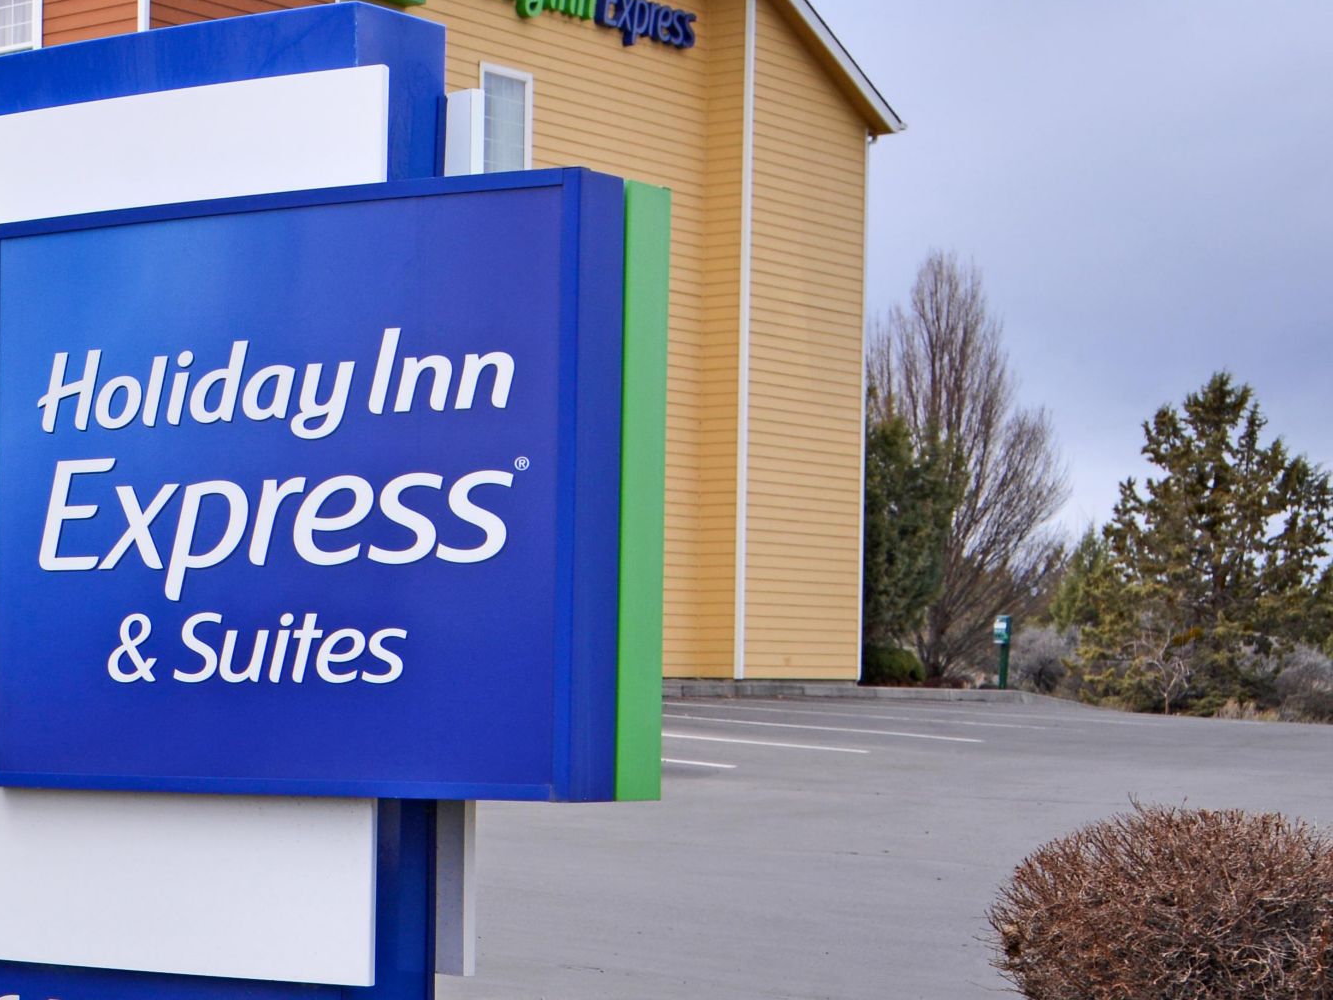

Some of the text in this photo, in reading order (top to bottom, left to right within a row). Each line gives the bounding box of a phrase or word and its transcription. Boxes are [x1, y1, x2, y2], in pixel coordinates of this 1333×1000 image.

[37, 327, 515, 440] Holiday Inn
[107, 612, 408, 685] & Suites
